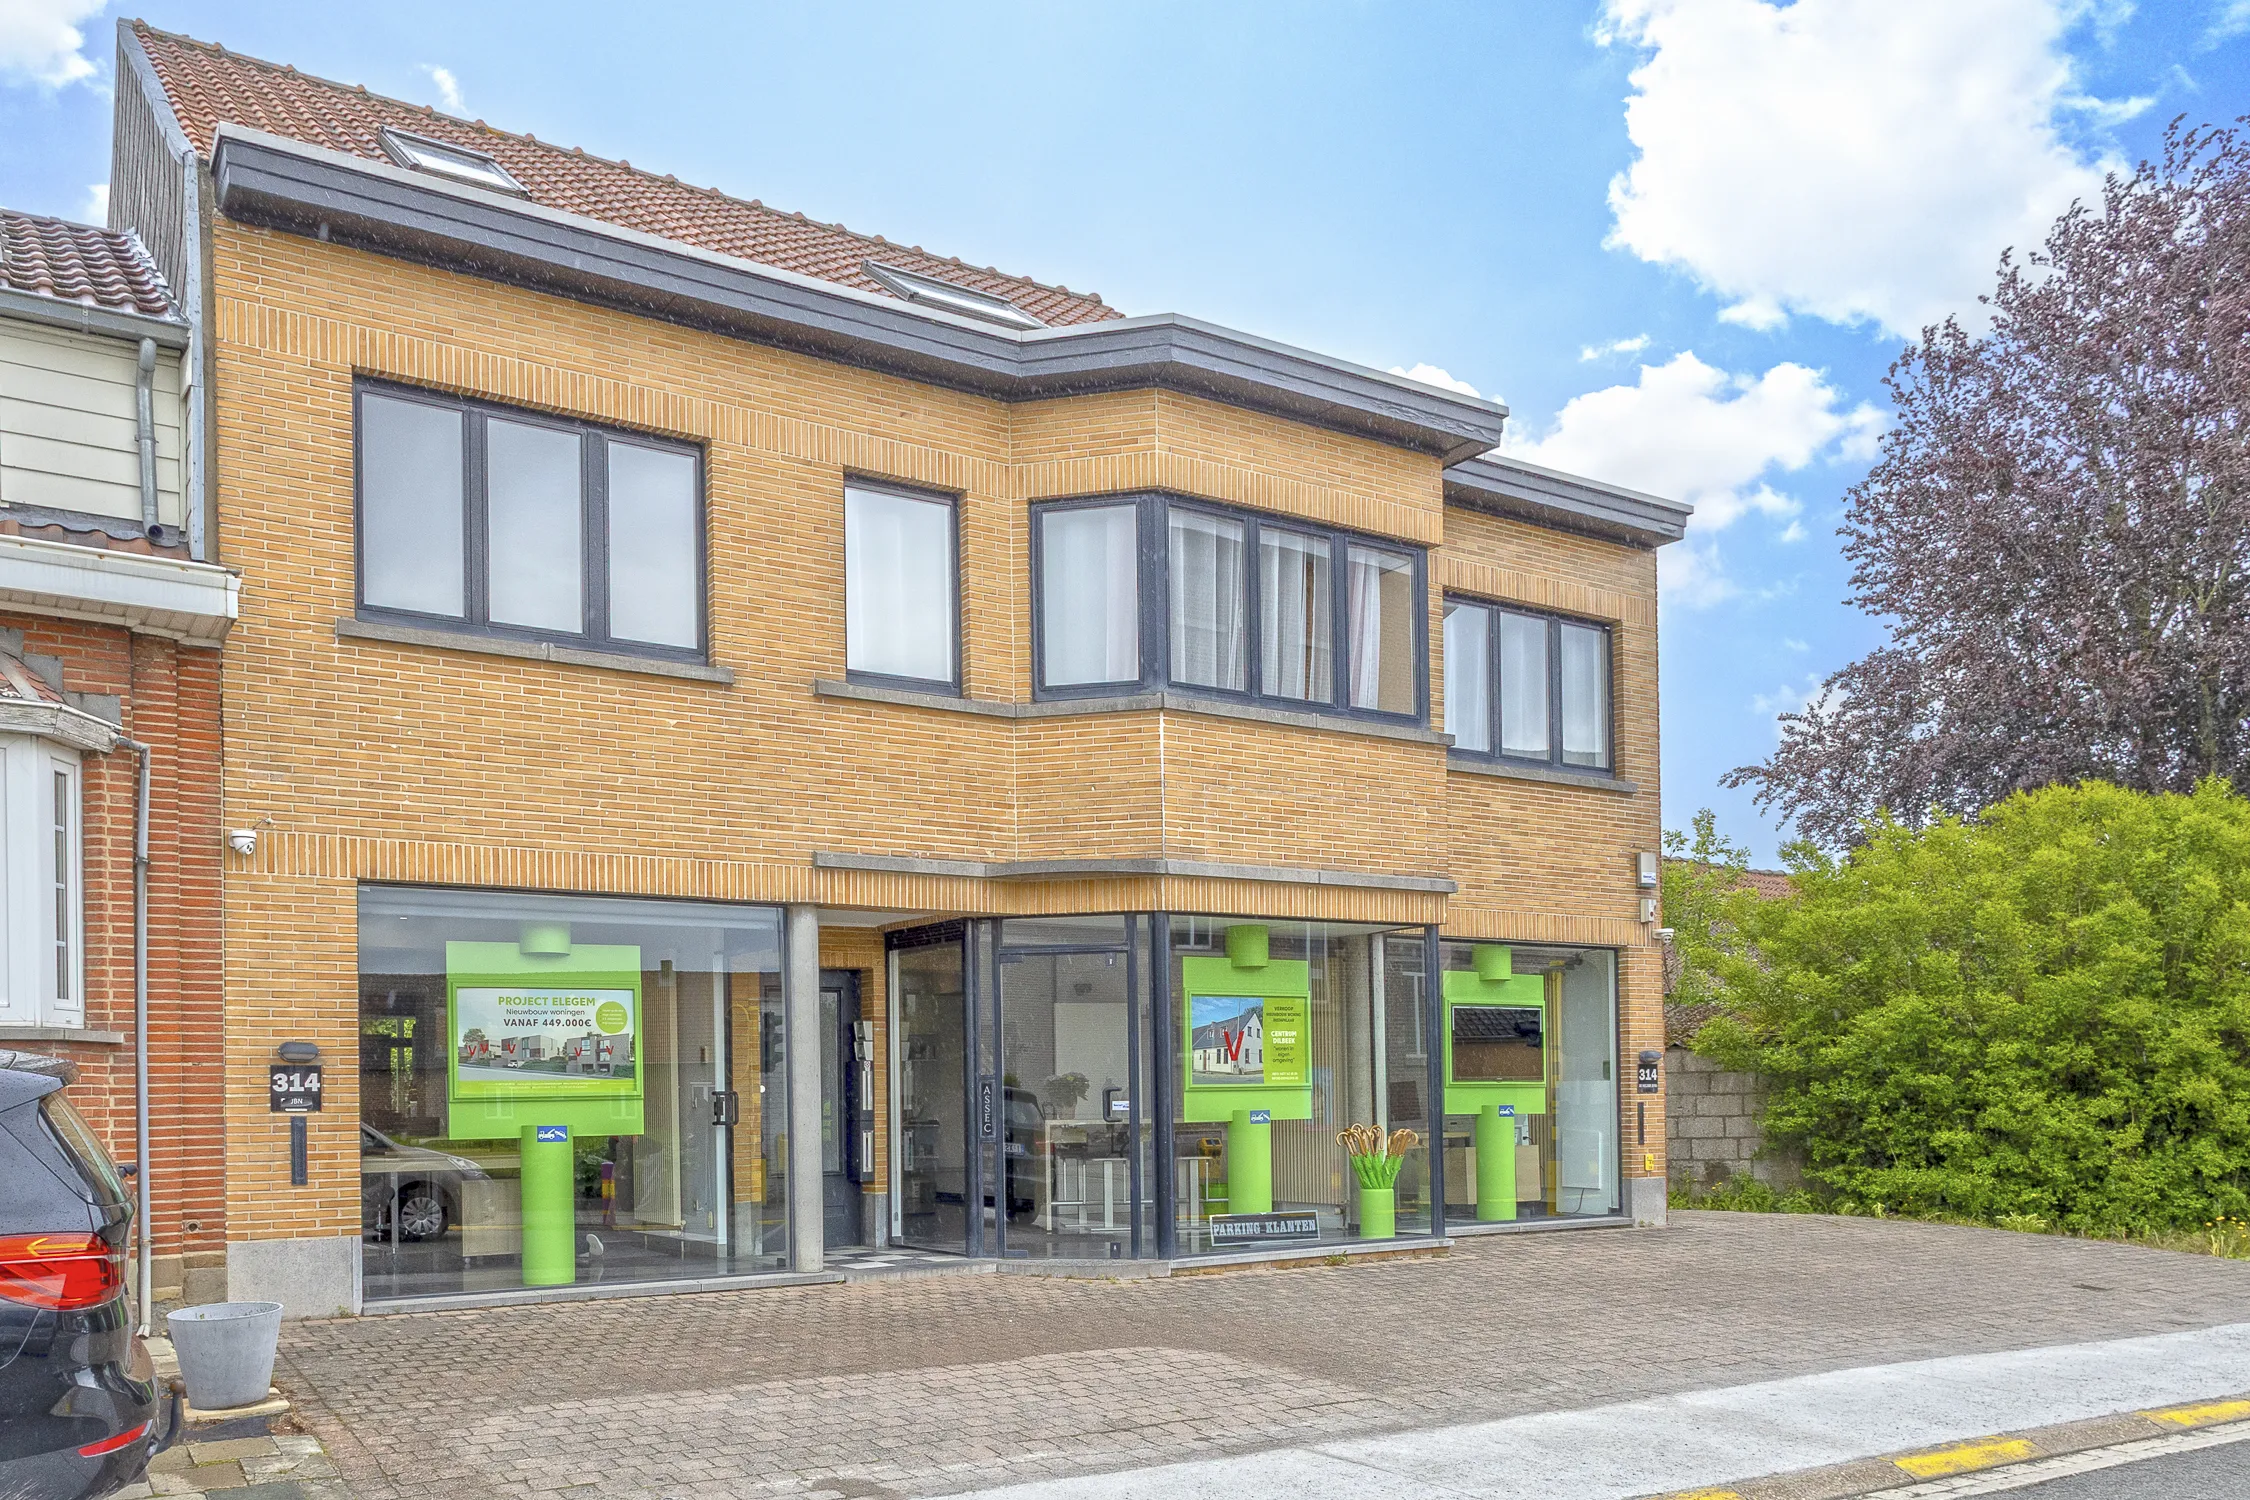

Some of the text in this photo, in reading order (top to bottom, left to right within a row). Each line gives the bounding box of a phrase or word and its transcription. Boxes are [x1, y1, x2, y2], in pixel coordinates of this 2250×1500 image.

[498, 996, 596, 1006] PROJECT ELEGEM
[549, 1008, 585, 1017] woningen
[503, 1018, 539, 1027] VANAF
[542, 1018, 592, 1027] 449.000€
[1638, 1068, 1658, 1081] 314
[272, 1072, 321, 1092] 314
[983, 1085, 992, 1133] ASSEC
[1213, 1219, 1316, 1236] PARKING KLANTEN
